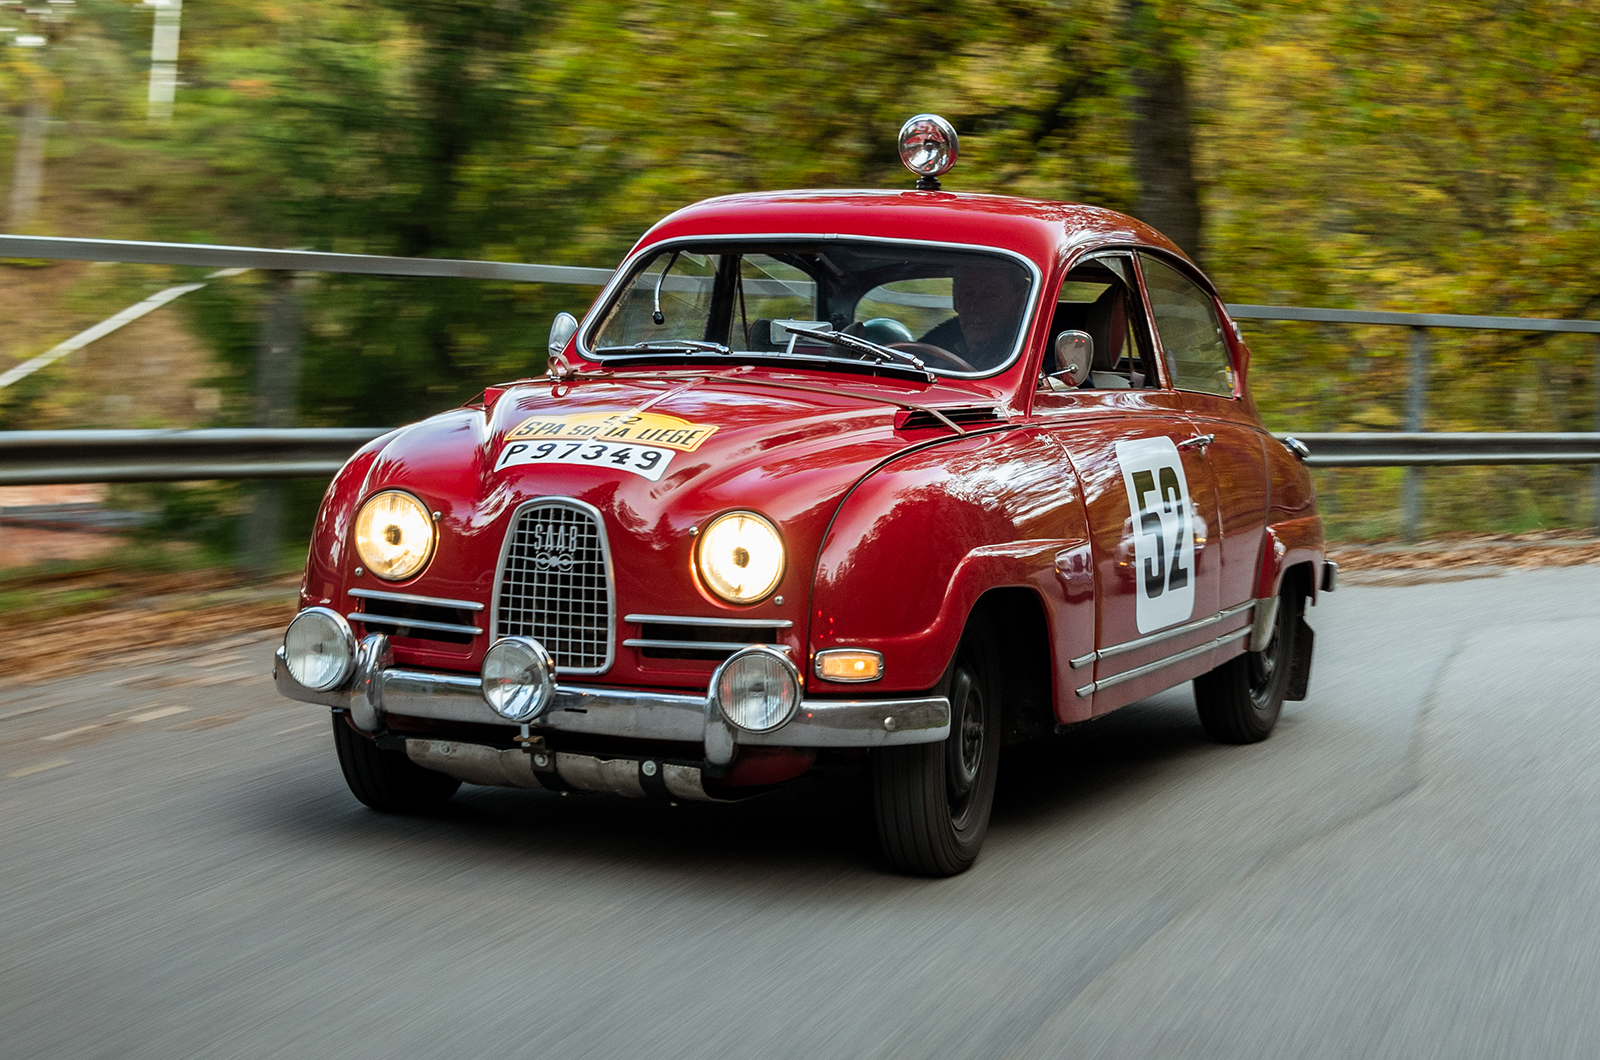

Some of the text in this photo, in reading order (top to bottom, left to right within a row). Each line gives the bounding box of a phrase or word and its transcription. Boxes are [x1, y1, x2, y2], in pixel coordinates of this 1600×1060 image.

[515, 421, 704, 446] SPA SOIA LIEGE
[534, 523, 578, 552] SAAB
[1131, 466, 1189, 599] 52
